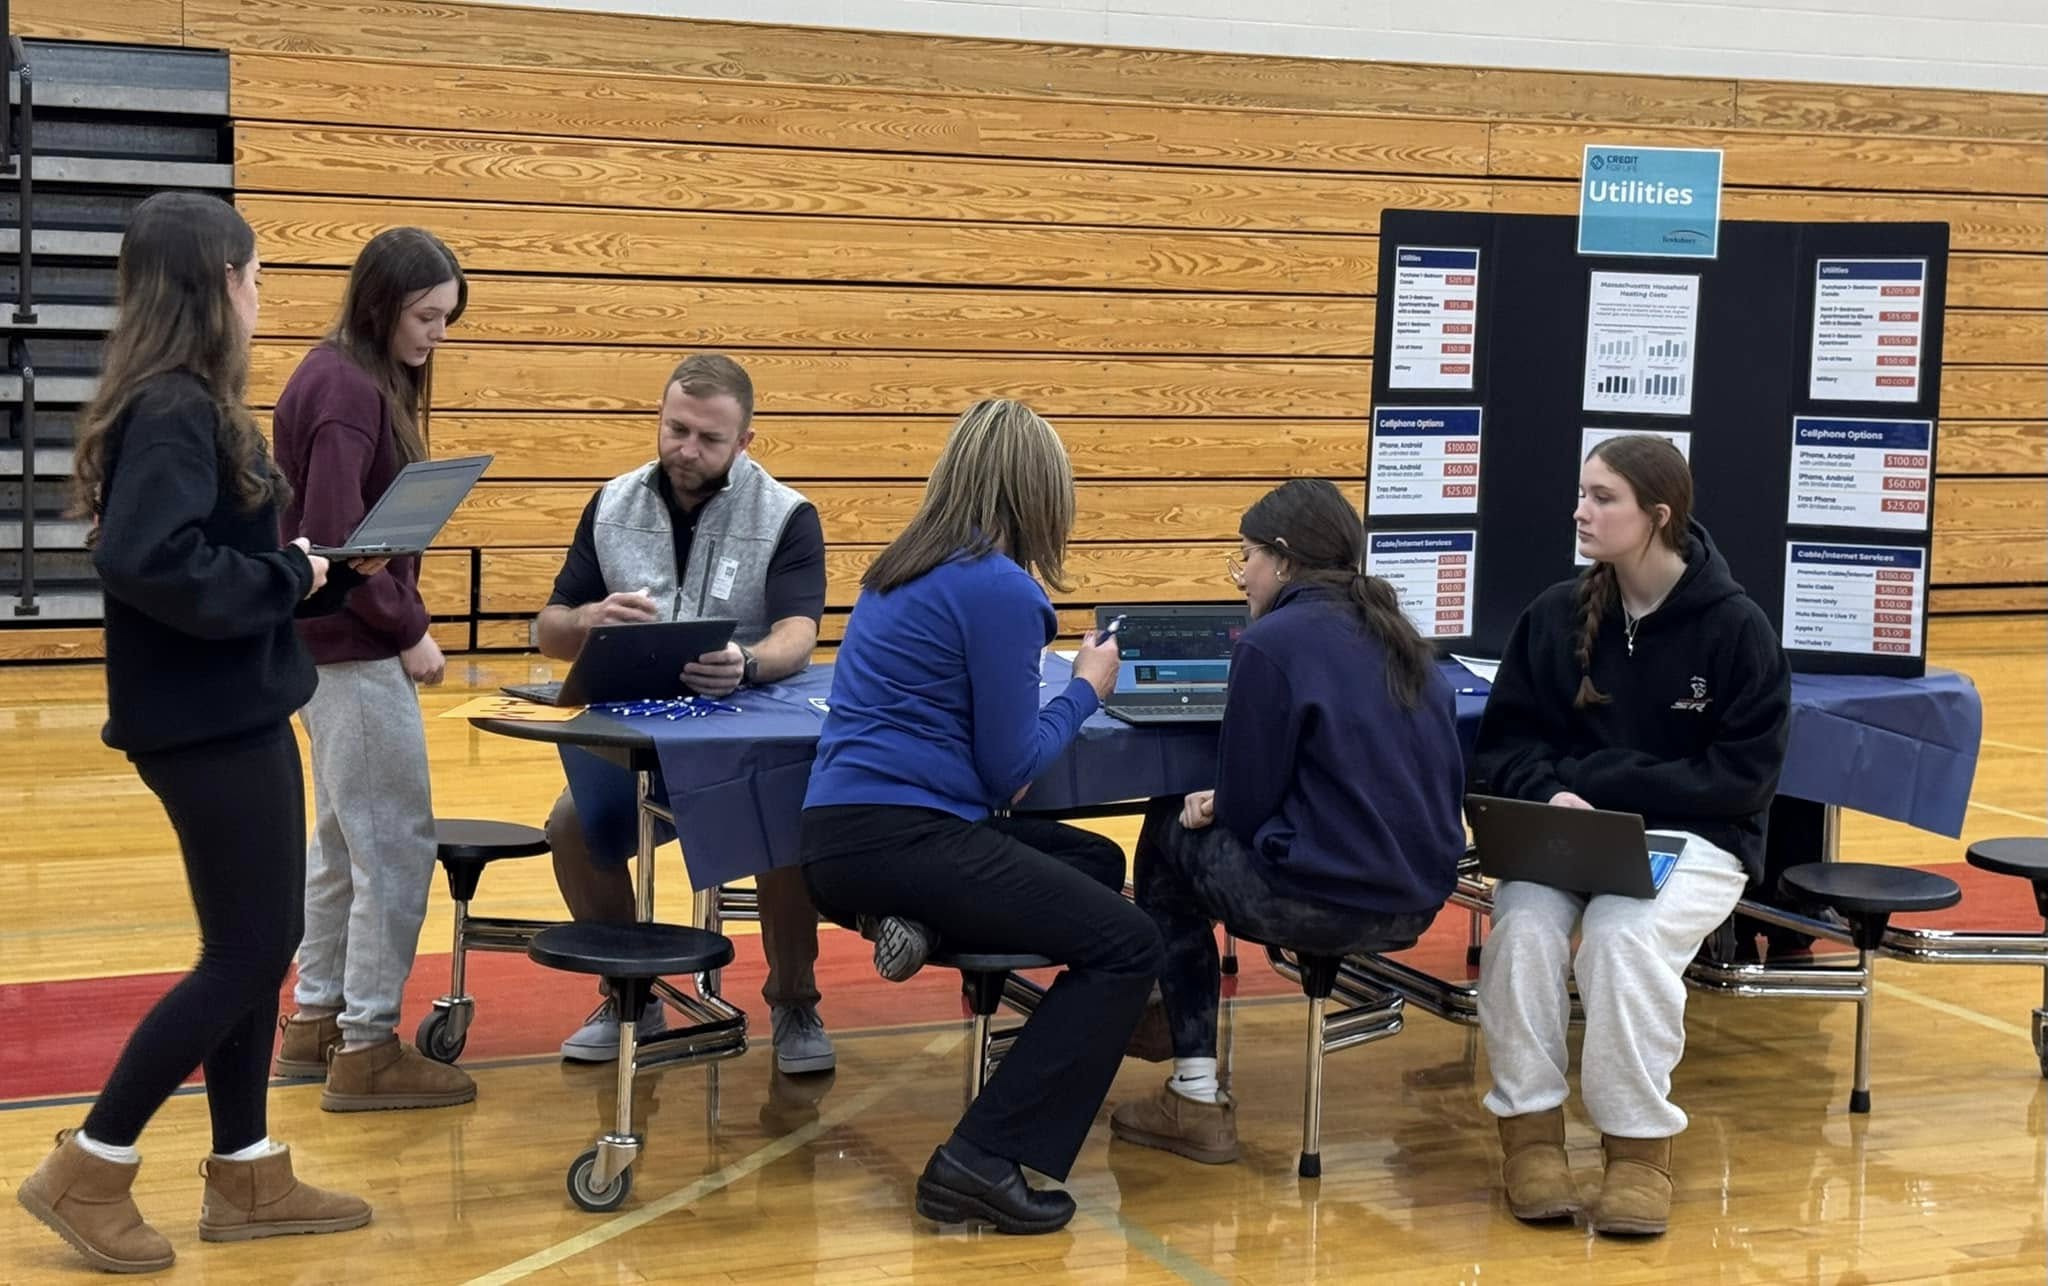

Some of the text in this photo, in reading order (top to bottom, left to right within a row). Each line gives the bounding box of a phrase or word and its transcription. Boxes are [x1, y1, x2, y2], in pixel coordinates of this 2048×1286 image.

[1607, 155, 1639, 165] CREDIT
[1606, 164, 1620, 172] FOR
[1589, 180, 1694, 205] Utilities
[1380, 419, 1445, 430] Cellphone Options
[1801, 428, 1883, 441] Cellphone Options
[1447, 443, 1476, 453] $100.00
[1799, 451, 1856, 460] iPhone, Android
[1887, 456, 1924, 466] $100.00
[1447, 465, 1473, 475] $60.00
[1798, 473, 1854, 482] iPhone, Android
[1887, 479, 1921, 489] $60.00
[1446, 486, 1472, 496] $25.00
[1887, 502, 1920, 511] $25.00
[1376, 539, 1424, 548] Cable/Internet
[1798, 550, 1894, 562] Cable/Internet Services
[1827, 570, 1874, 578] Cable/Internet
[1880, 600, 1908, 608] $50.00
[1879, 615, 1906, 623] $55.00
[1795, 625, 1813, 633] Apple
[1882, 629, 1904, 637] $5.00
